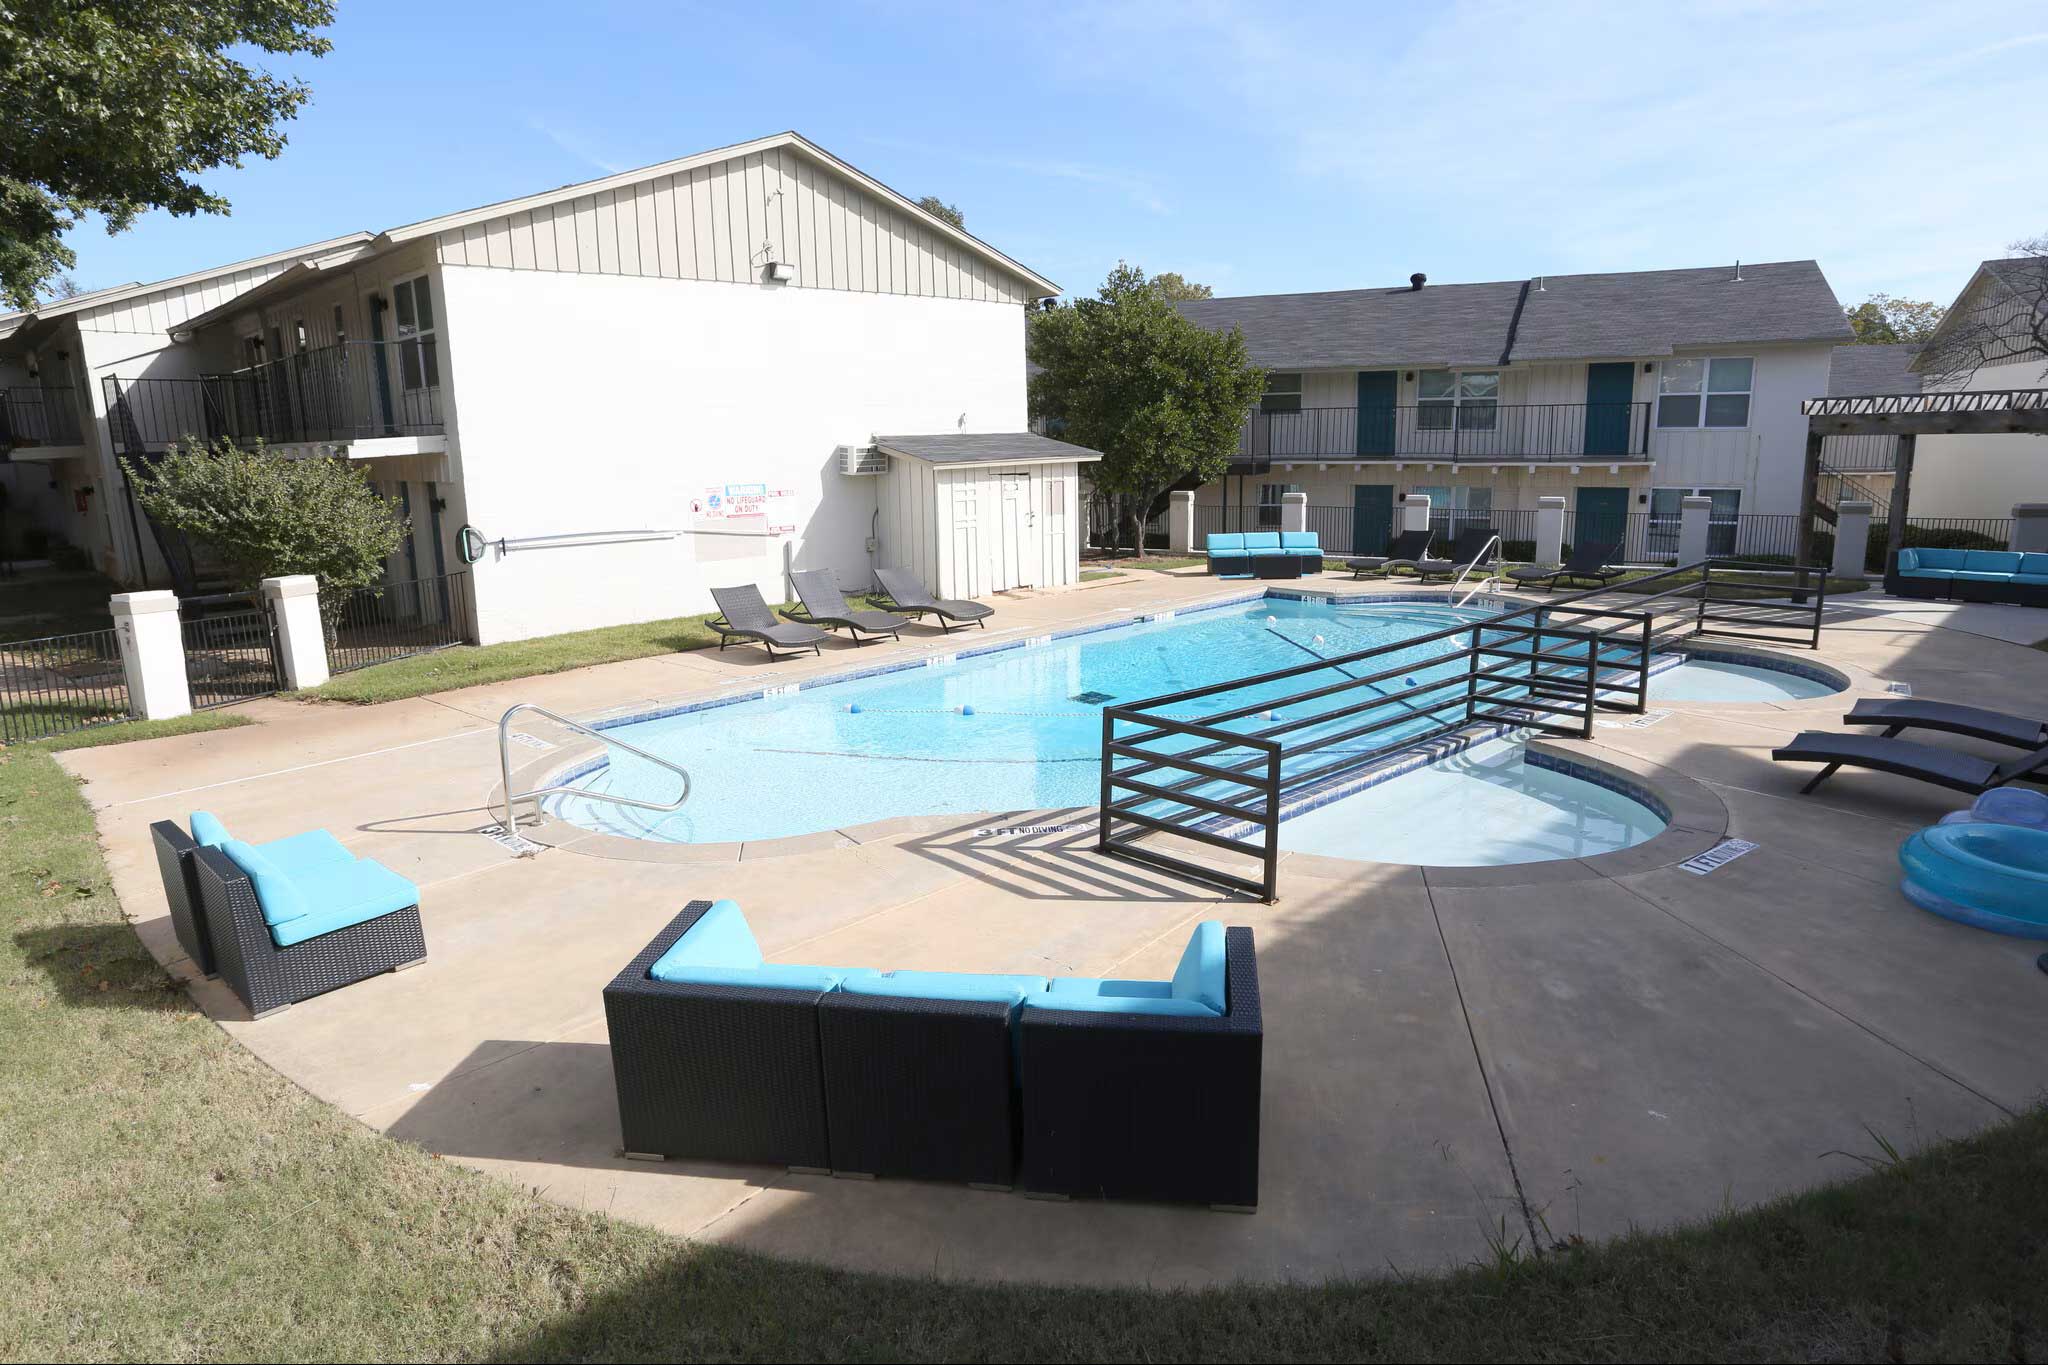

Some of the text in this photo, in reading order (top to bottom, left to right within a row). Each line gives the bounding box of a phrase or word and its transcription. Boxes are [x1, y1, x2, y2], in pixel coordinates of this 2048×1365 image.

[736, 496, 766, 504] LIFEGUARD
[734, 504, 759, 513] ON DUTY
[978, 824, 1064, 837] 3 FT NO DIVING
[1684, 855, 1721, 873] 1 FT
